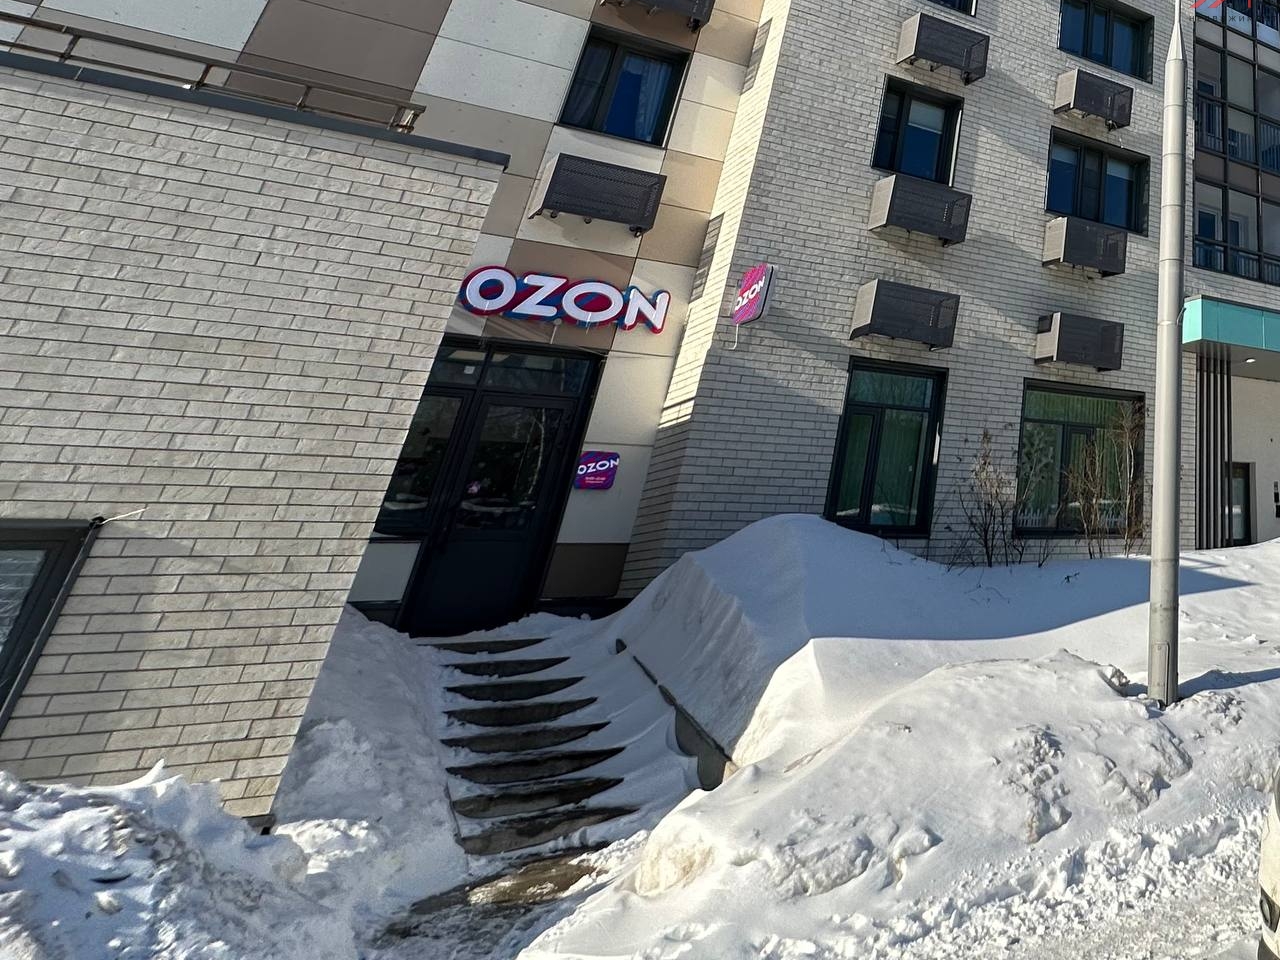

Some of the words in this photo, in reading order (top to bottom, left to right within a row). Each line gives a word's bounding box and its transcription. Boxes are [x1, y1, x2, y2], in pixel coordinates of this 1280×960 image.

[465, 268, 671, 334] OZON
[735, 276, 766, 310] OZON
[577, 458, 620, 475] OZON
